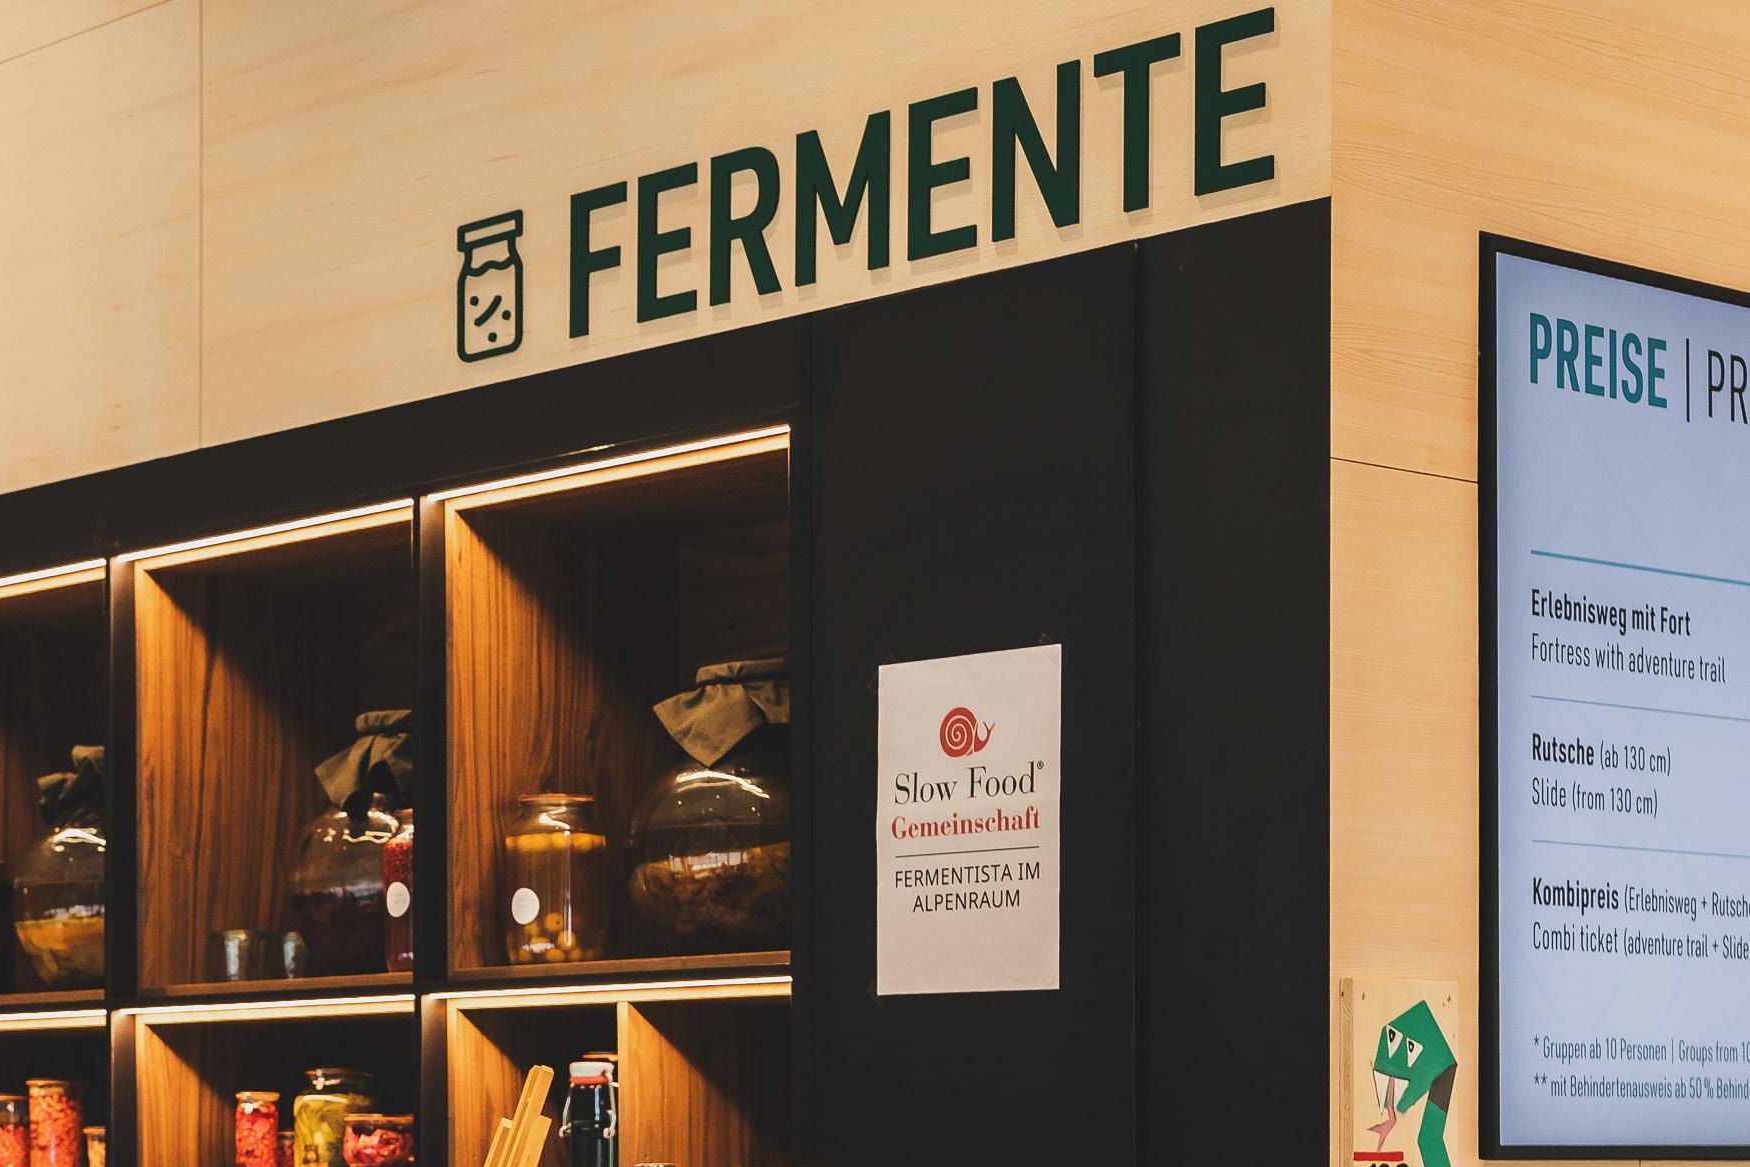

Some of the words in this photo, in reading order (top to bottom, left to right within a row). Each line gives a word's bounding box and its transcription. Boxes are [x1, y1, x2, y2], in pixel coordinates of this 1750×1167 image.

[568, 7, 1275, 339] FERMENTE
[1530, 312, 1667, 409] PREISE
[1707, 349, 1749, 425] PR
[1531, 588, 1627, 636] Erlebnisweg
[1631, 603, 1656, 632] mit
[1660, 606, 1691, 636] Fort
[1531, 632, 1591, 667] Fortress
[1595, 642, 1624, 672] with
[1628, 646, 1695, 680] adventure
[1699, 656, 1727, 684] trail
[1532, 732, 1595, 766] Rutsche
[1600, 739, 1619, 771] (ab
[1623, 744, 1646, 772] 130
[1649, 746, 1671, 777] cm)
[893, 771, 957, 805] Slow
[1532, 777, 1567, 808] Slide
[1572, 780, 1605, 812] (from
[1610, 786, 1632, 813] 130
[1635, 788, 1658, 819] cm)
[891, 804, 1041, 840] Gemeinschaft
[895, 862, 1013, 889] FERMENTISTA
[1018, 861, 1041, 881] IM
[912, 888, 1020, 913] ALPENRAUM
[1532, 876, 1619, 917] Kombipreis
[1624, 883, 1697, 922] (Erlebnisweg
[1700, 896, 1708, 910] +
[1532, 921, 1575, 952] Combi
[1580, 923, 1619, 953] ticket
[1623, 927, 1683, 958] (adventure
[1686, 933, 1709, 958] trail
[1712, 939, 1719, 952] +
[1543, 1035, 1587, 1065] Gruppen
[1589, 1037, 1602, 1059] ab
[1605, 1037, 1617, 1060] 10
[1620, 1037, 1667, 1061] Personen
[1678, 1039, 1713, 1068] Groups
[1716, 1040, 1738, 1062] from
[1550, 1074, 1567, 1097] mit
[1570, 1074, 1673, 1098] Behindertenausweis
[1674, 1076, 1687, 1099] ab
[1716, 1076, 1749, 1100] Behind
